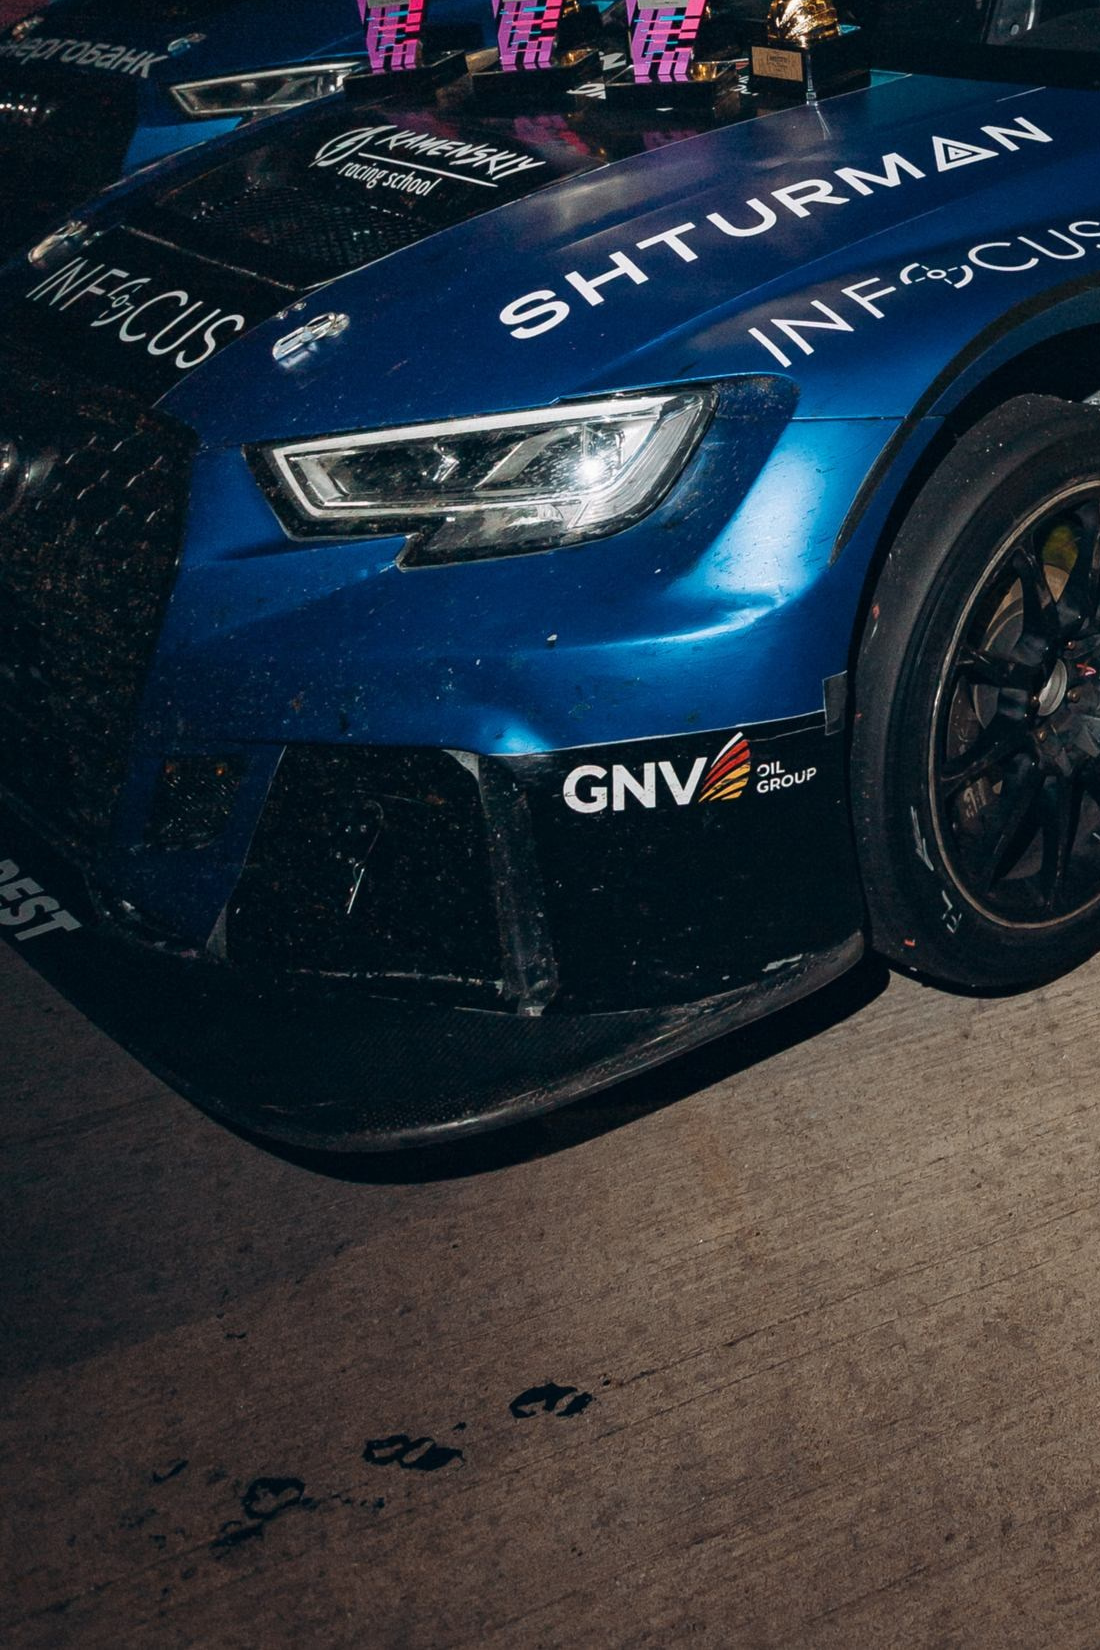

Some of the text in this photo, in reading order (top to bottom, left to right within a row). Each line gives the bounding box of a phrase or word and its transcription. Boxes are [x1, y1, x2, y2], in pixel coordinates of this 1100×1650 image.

[337, 160, 442, 197] racing school
[374, 129, 547, 181] KAMENSKIY
[499, 116, 1053, 340] SHTURMAN
[25, 256, 246, 370] INFOCUS
[562, 756, 708, 814] GNV
[756, 760, 786, 778] OIL
[756, 766, 818, 794] GROUP
